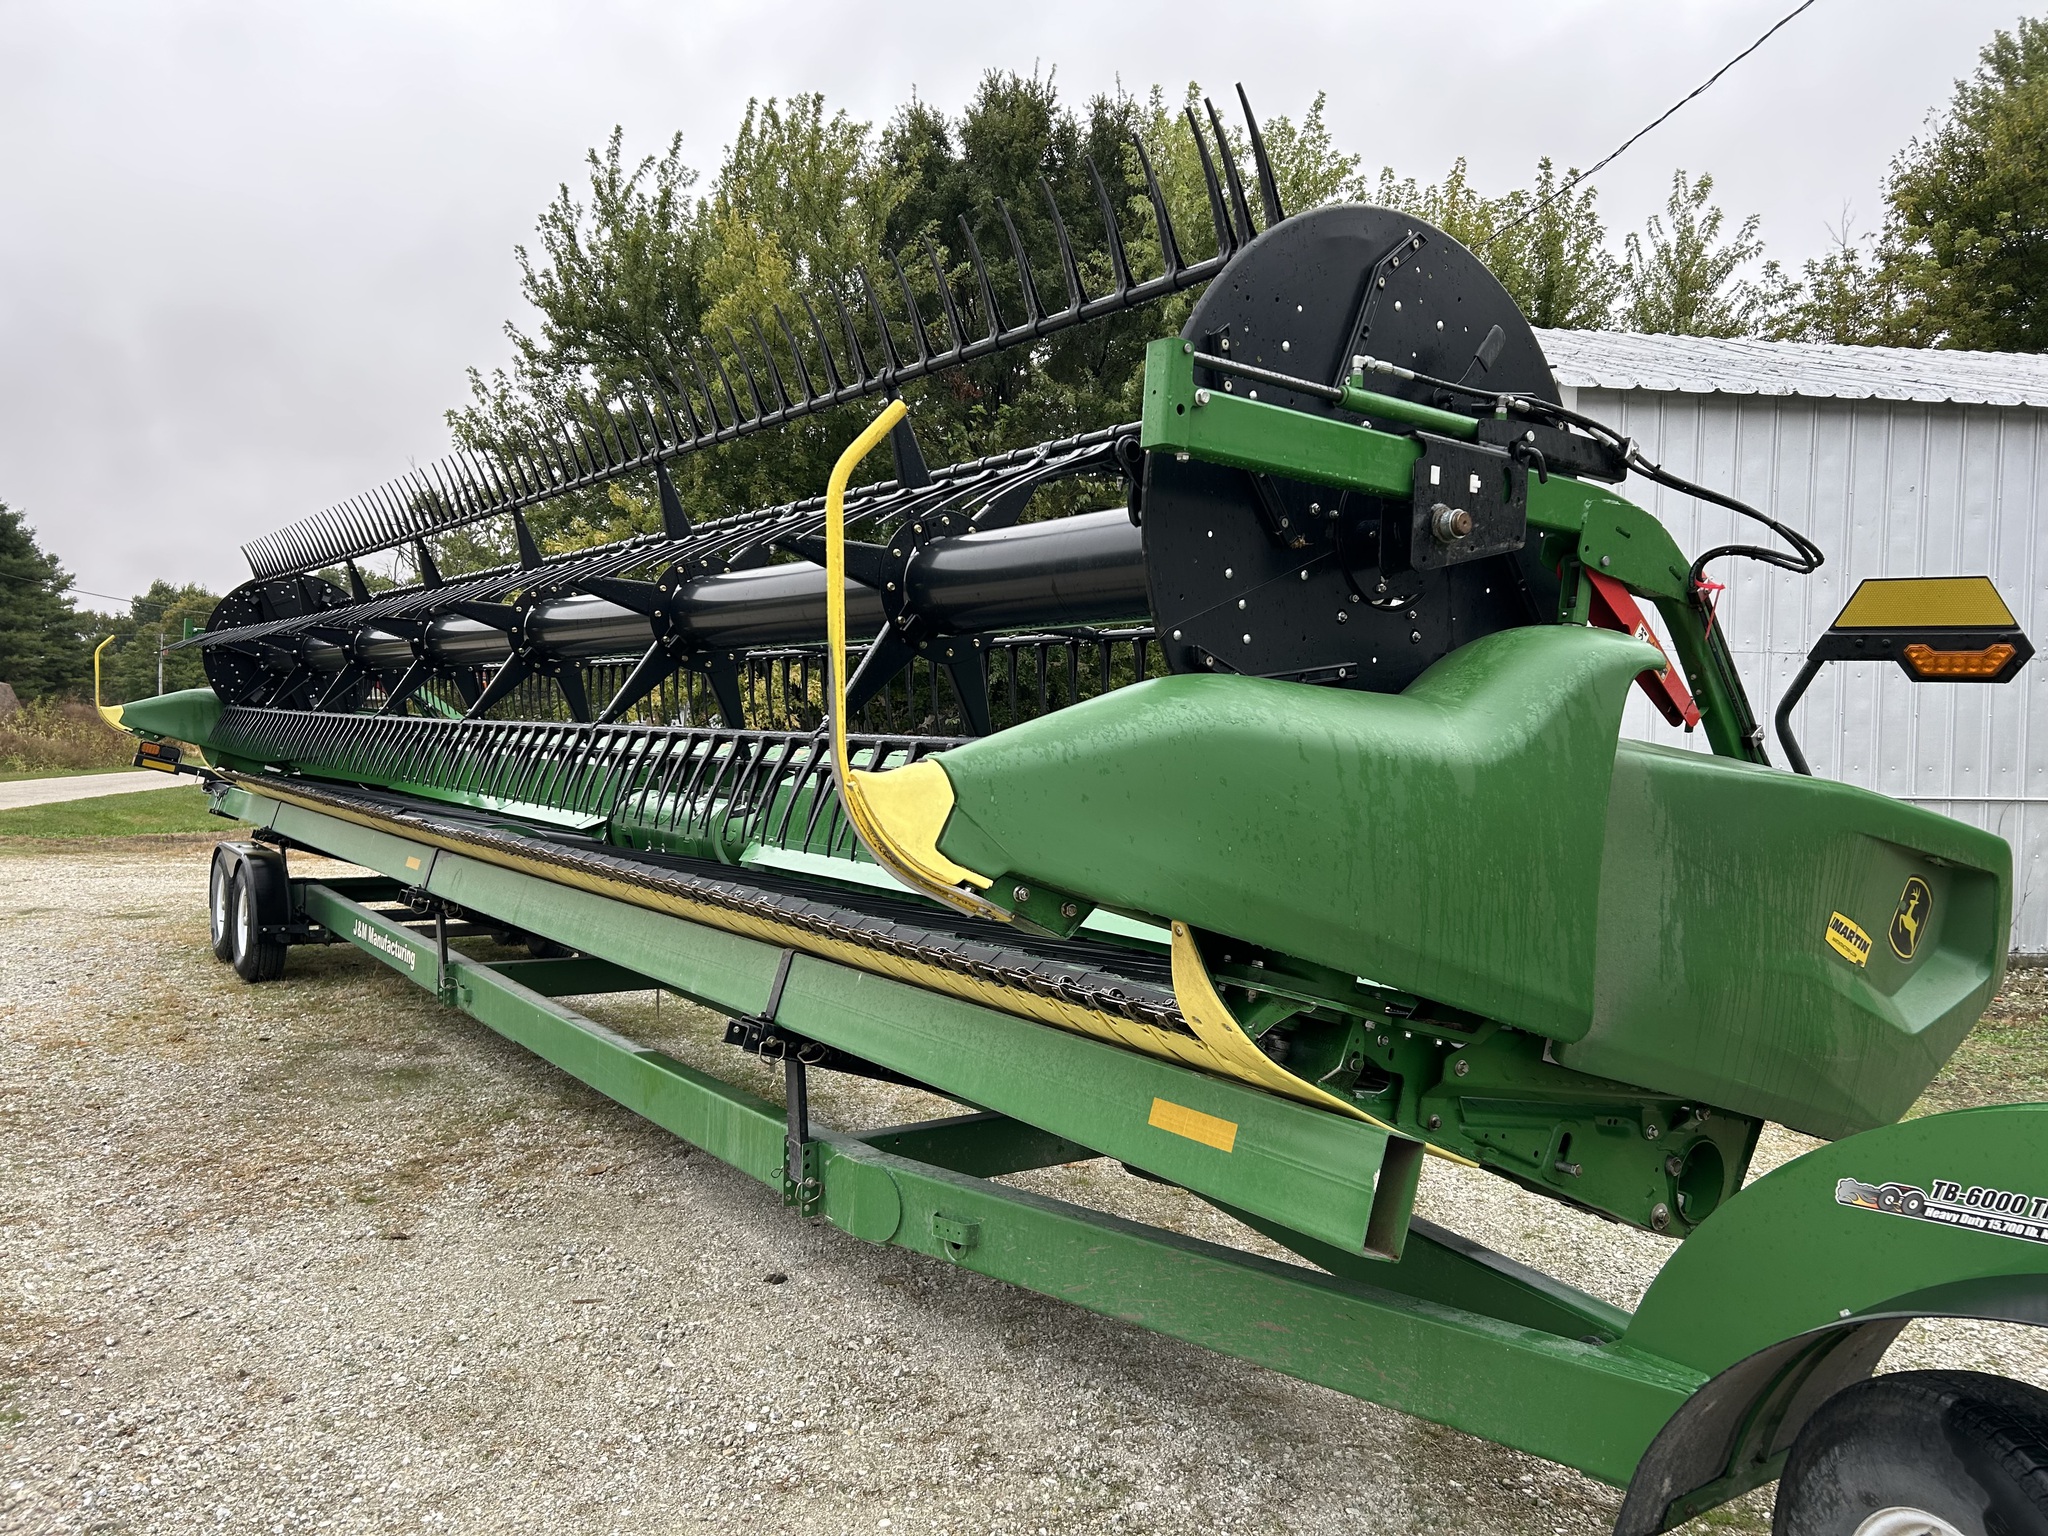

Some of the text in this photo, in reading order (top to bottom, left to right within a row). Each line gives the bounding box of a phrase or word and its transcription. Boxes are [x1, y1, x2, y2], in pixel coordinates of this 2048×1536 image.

[353, 919, 416, 972] J&M Manufacturing
[1830, 916, 1870, 954] MARTIN
[1931, 1180, 2028, 1215] TB-6000
[1924, 1206, 1960, 1223] Heavy
[1959, 1213, 1987, 1228] Duty
[1988, 1219, 2025, 1235] 15,700
